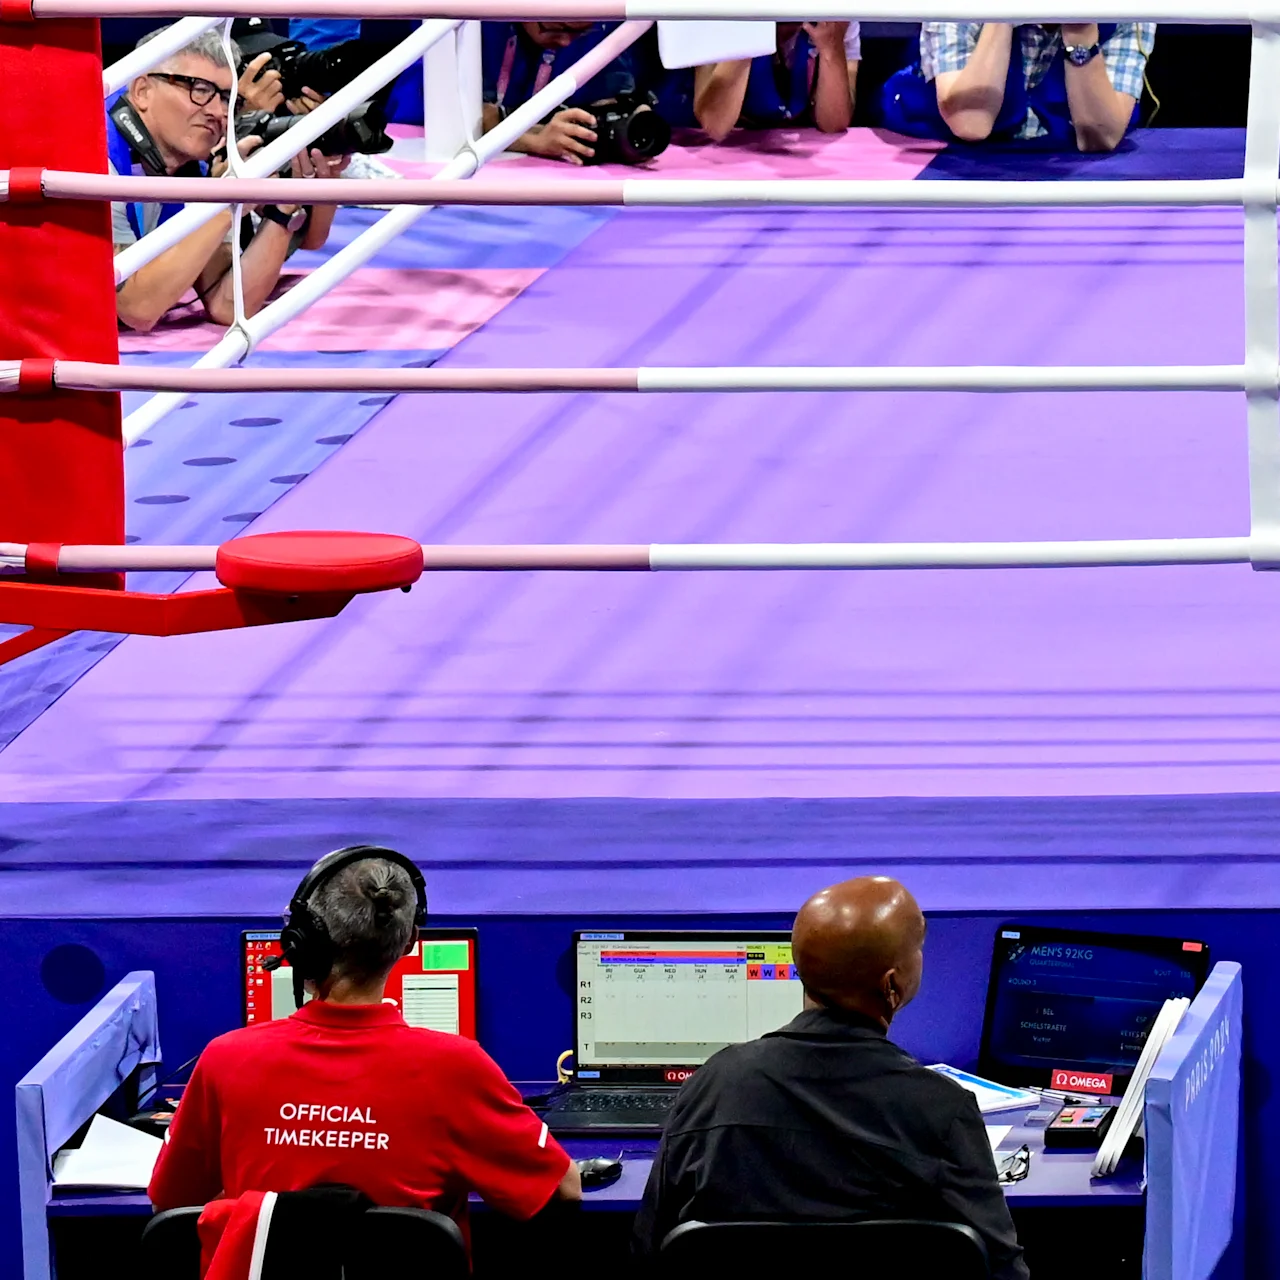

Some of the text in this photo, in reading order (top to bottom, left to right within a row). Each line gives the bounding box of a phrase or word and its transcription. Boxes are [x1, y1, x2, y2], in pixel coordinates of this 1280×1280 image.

[1030, 945, 1094, 960] MEN'S 92KG
[580, 981, 591, 989] R1
[580, 1012, 592, 1020] R3
[584, 1043, 589, 1051] T
[1070, 1076, 1107, 1088] OMEGA
[279, 1102, 377, 1124] OFFICIAL
[263, 1127, 390, 1150] TIMEKEEPER
